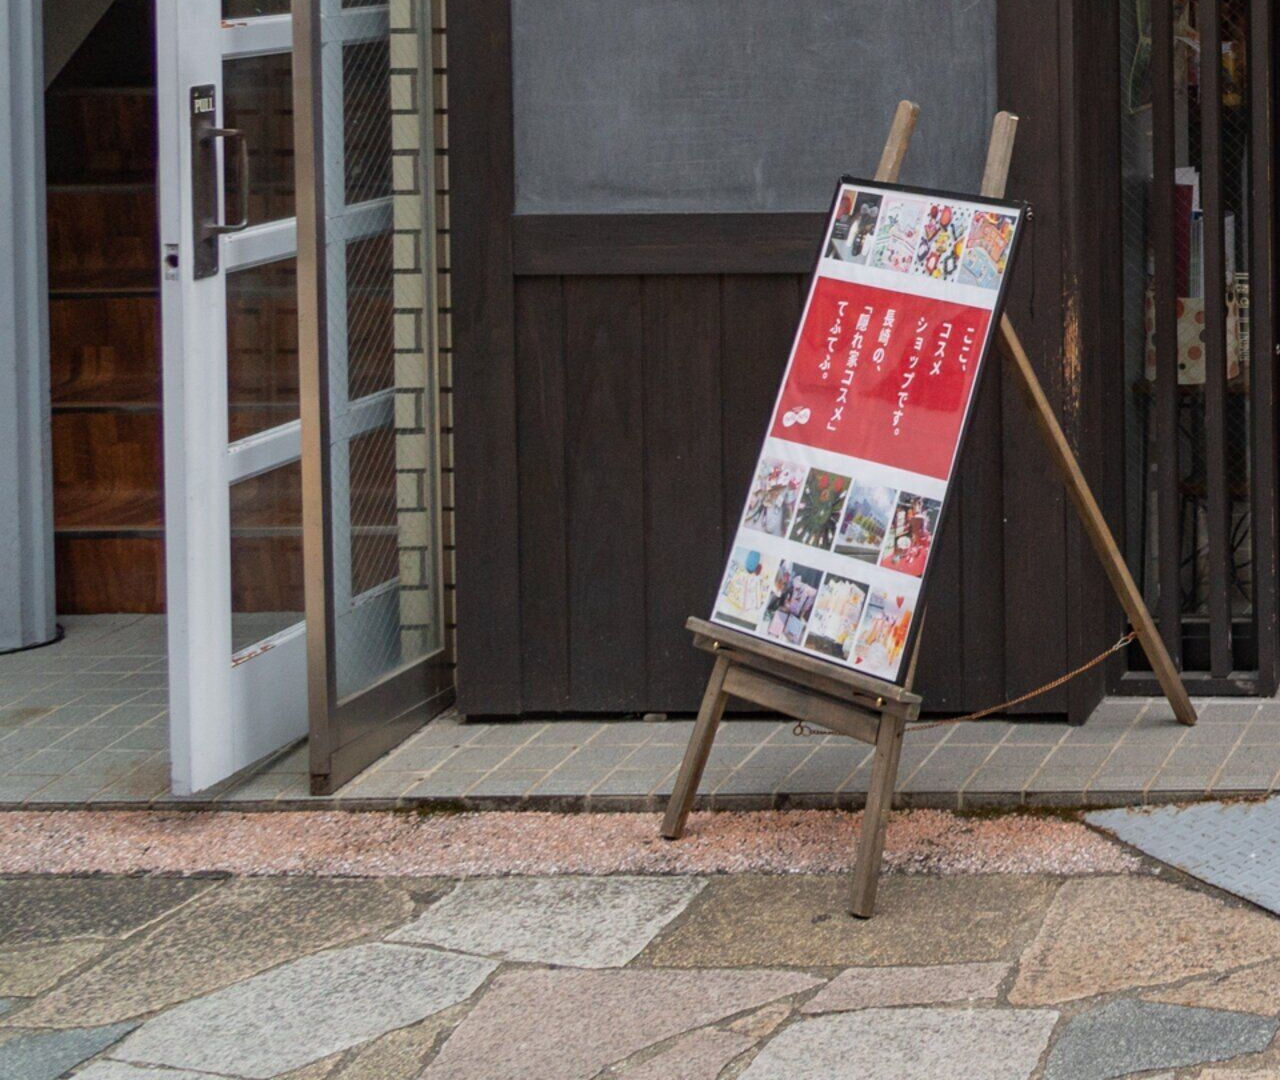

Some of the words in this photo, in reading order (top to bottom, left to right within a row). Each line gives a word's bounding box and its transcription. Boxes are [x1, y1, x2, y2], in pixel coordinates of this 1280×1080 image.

[194, 97, 216, 113] PULL
[819, 301, 848, 380] てふてふ。
[872, 309, 896, 372] 長崎の、
[930, 323, 952, 375] コスメ
[959, 327, 975, 371] ここ、
[892, 317, 927, 436] ショップです。
